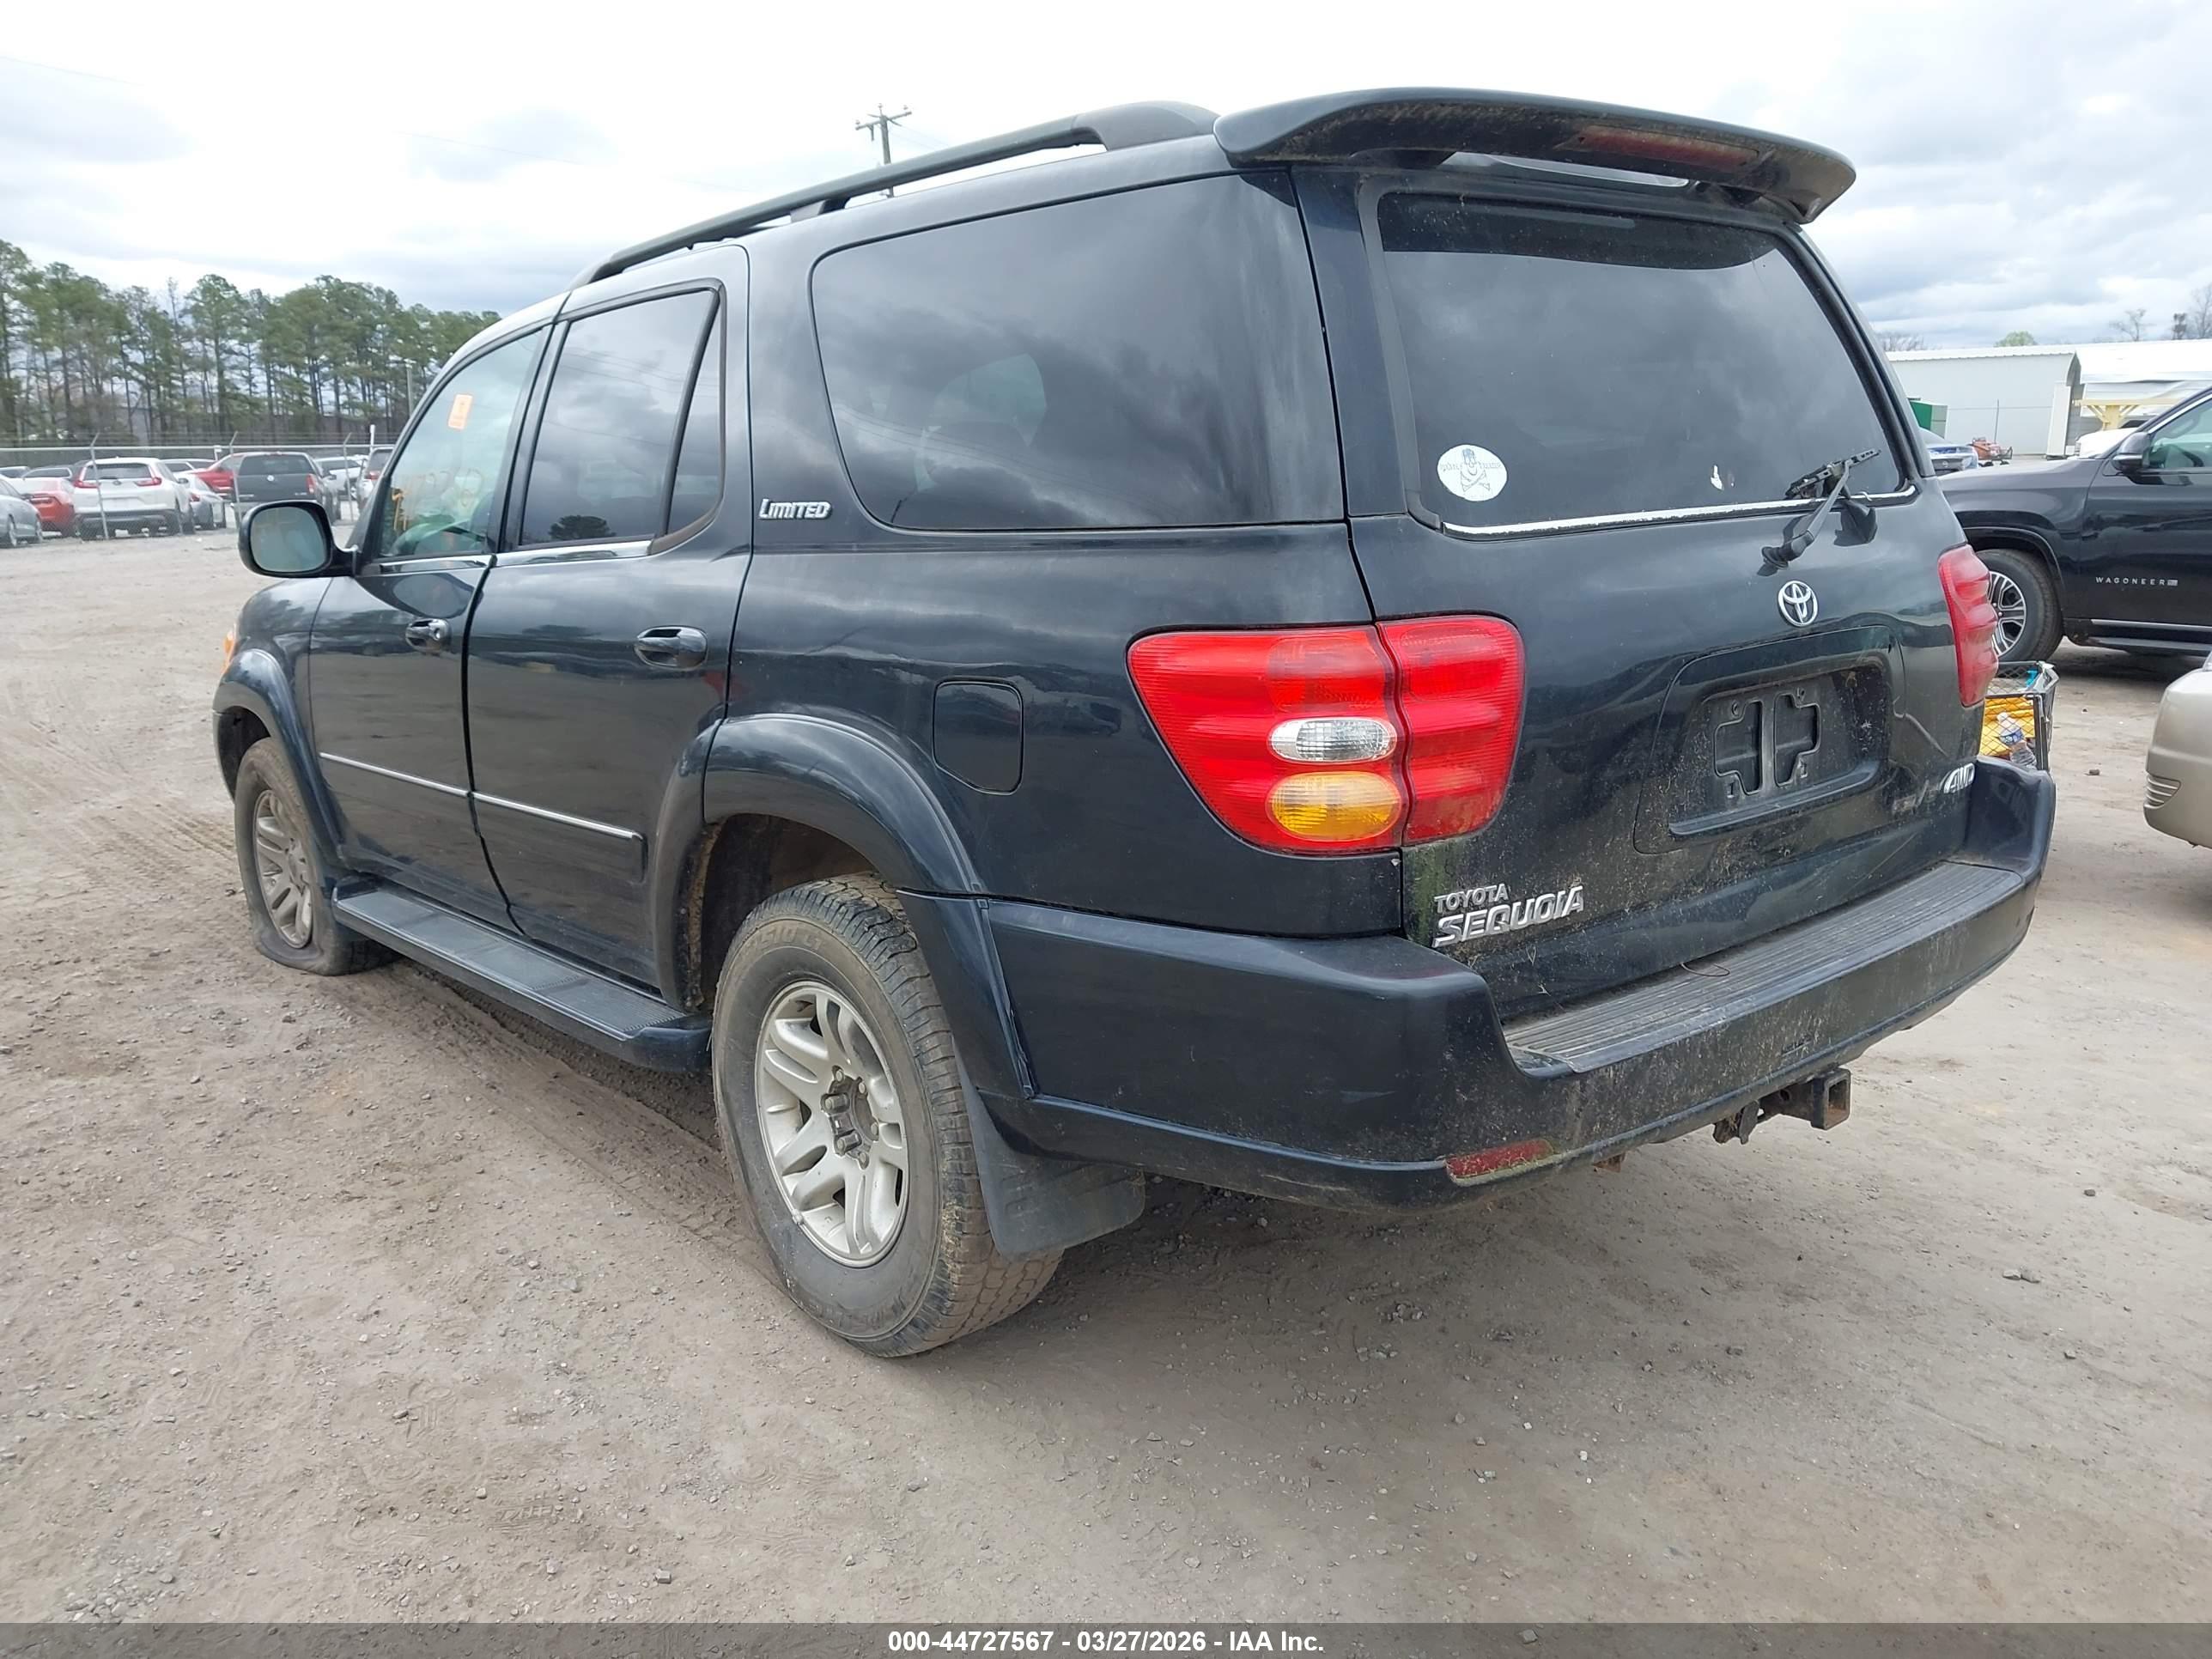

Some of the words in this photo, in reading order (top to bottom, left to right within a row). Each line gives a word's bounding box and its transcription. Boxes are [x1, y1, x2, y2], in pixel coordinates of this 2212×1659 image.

[2095, 576, 2166, 586] WAGONEER
[1433, 884, 1510, 914] TOYOTA
[1431, 885, 1583, 948] SEQUOIA
